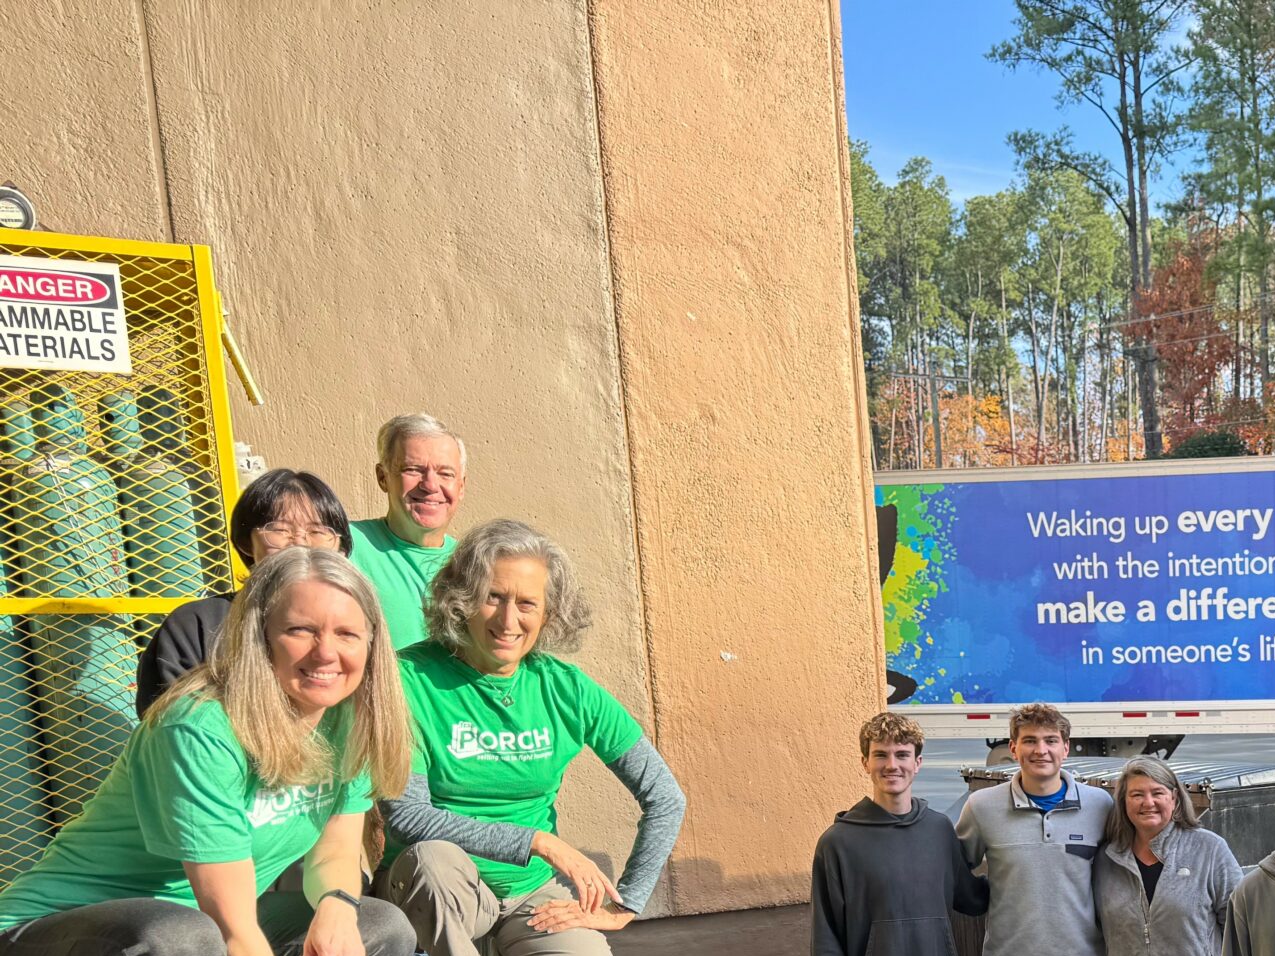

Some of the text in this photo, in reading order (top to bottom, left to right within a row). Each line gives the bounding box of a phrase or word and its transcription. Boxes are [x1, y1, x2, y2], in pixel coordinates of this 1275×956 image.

[1026, 508, 1126, 543] Waking
[1134, 514, 1169, 544] up
[1176, 507, 1274, 540] every
[1053, 552, 1108, 579] with
[1115, 551, 1159, 578] the
[1037, 591, 1126, 624] make
[1136, 600, 1156, 622] a
[1081, 640, 1103, 665] in
[456, 726, 551, 751] PORCH
